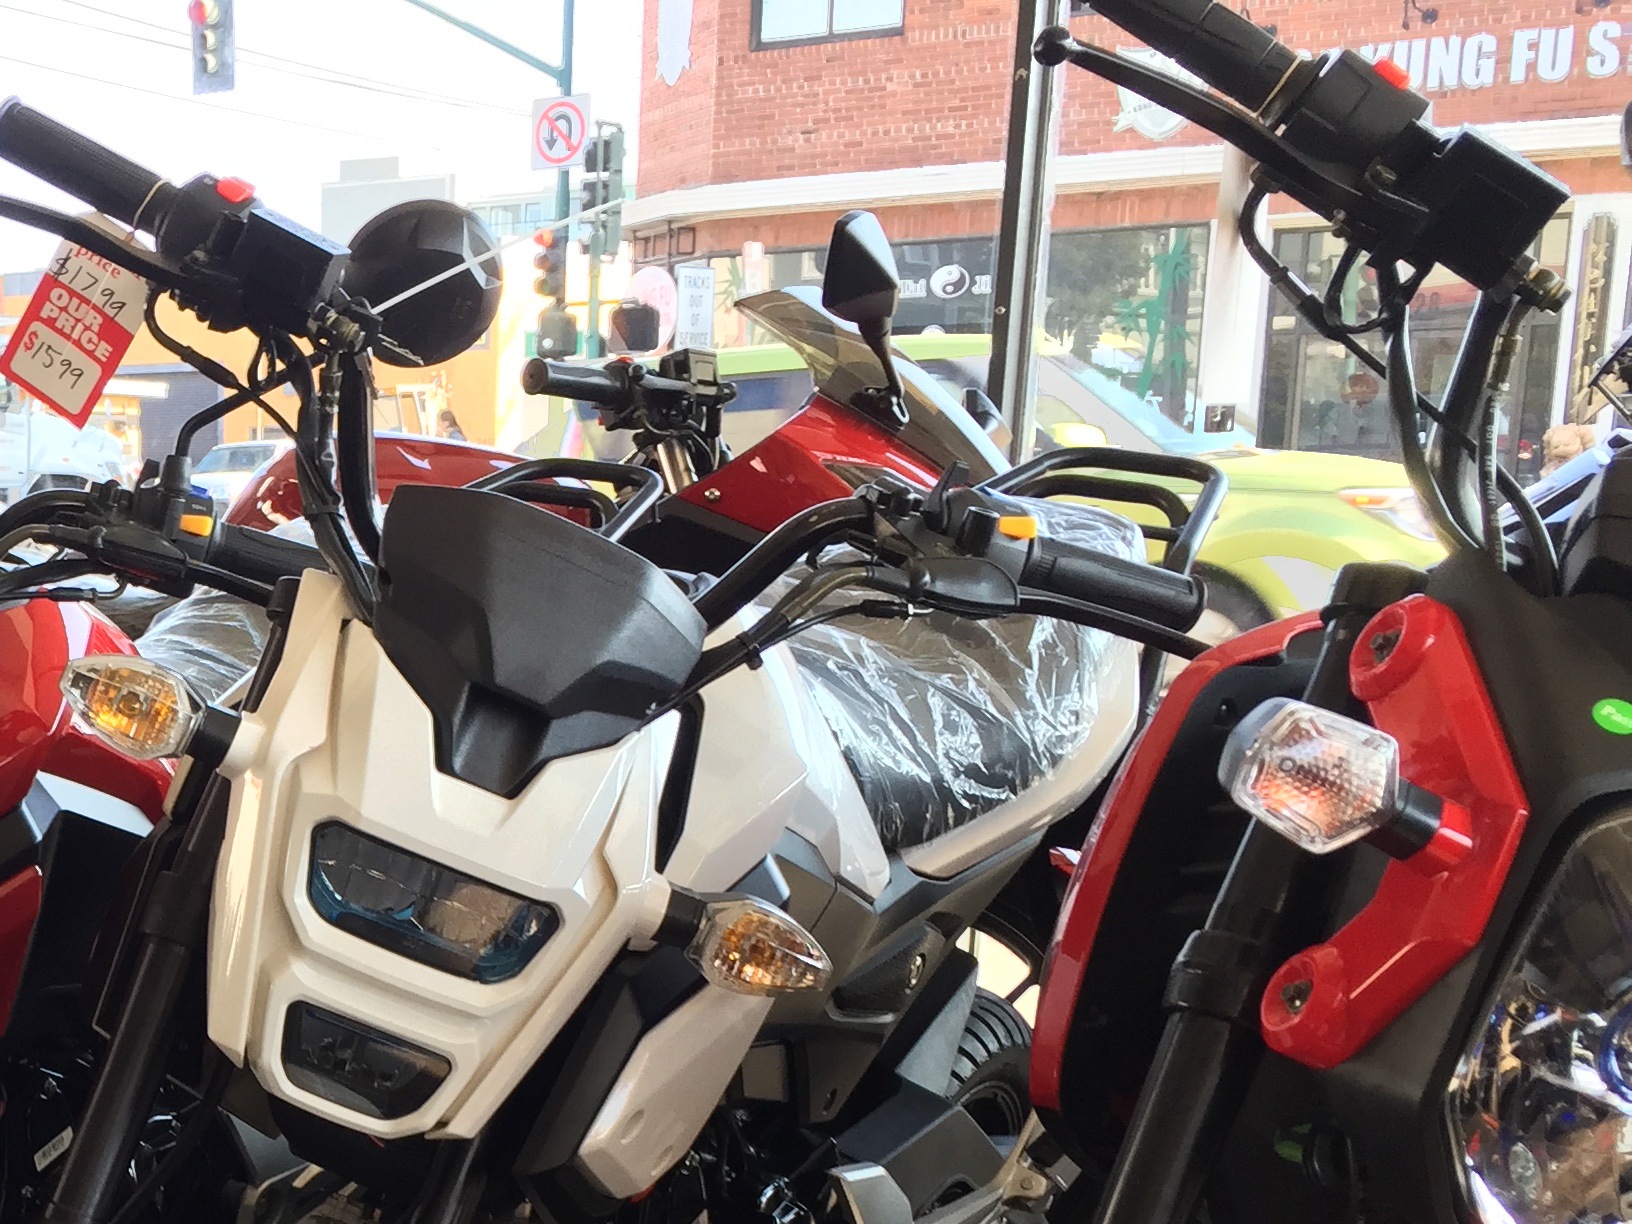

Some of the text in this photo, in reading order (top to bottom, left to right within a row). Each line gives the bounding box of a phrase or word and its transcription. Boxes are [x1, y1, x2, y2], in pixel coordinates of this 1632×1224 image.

[1510, 25, 1574, 84] FU
[1586, 20, 1630, 79] S
[50, 248, 127, 320] $1799
[684, 275, 710, 290] TRACKS
[690, 294, 704, 308] OUT
[39, 301, 113, 362] PRICE
[49, 287, 104, 333] OUR
[690, 313, 701, 327] OF
[22, 330, 84, 390] $1599
[679, 332, 709, 346] SERVICE
